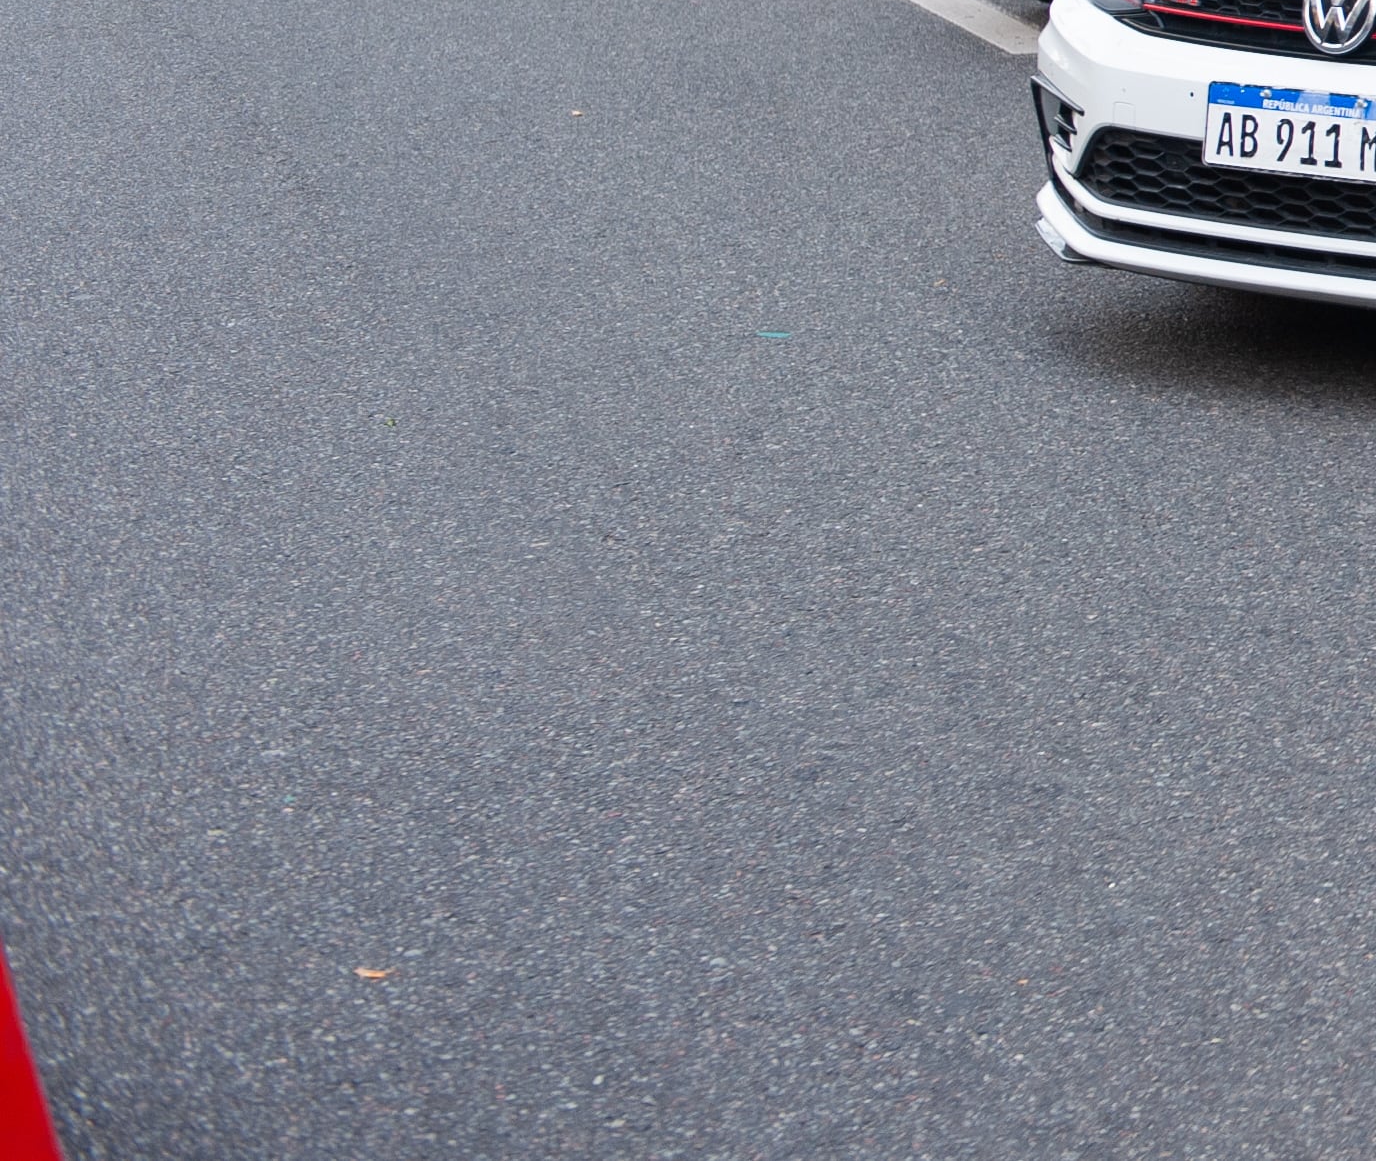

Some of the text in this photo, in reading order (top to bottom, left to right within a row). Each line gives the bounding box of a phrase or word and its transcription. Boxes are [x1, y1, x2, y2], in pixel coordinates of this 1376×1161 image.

[1262, 97, 1364, 120] REPÚBLICA ARGENTINA
[1215, 111, 1259, 158] AB
[1276, 118, 1343, 168] 911
